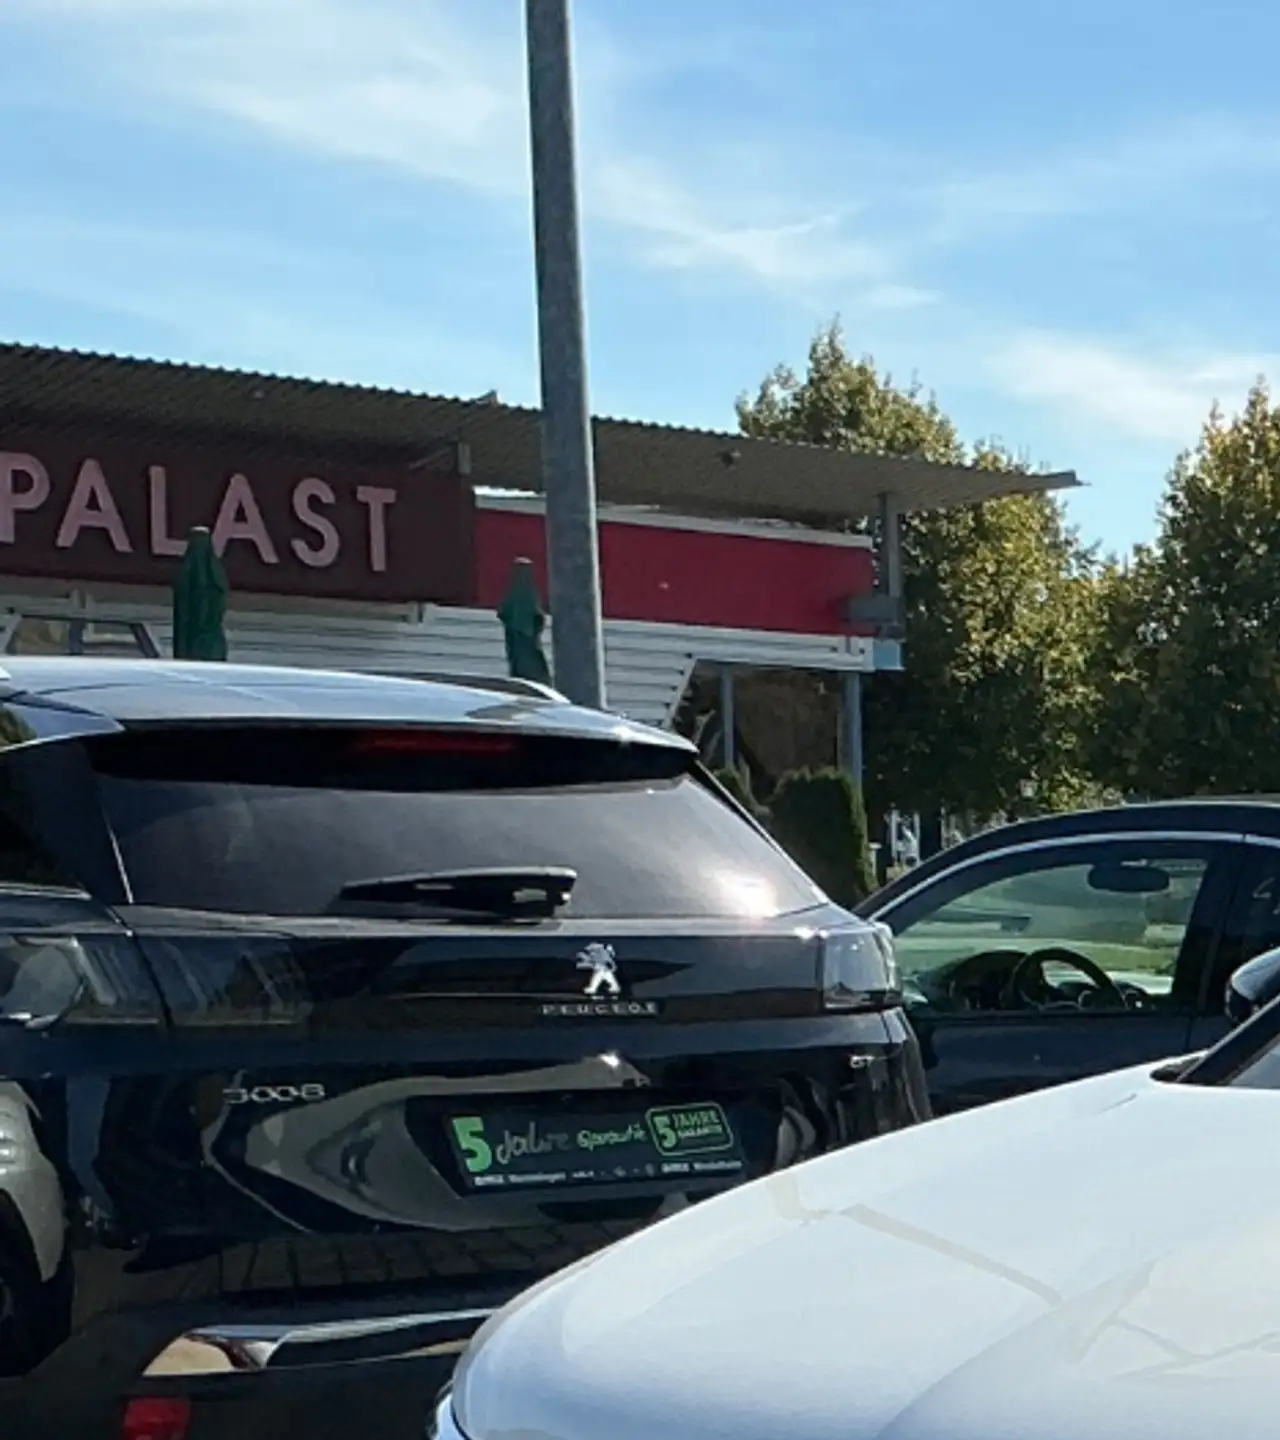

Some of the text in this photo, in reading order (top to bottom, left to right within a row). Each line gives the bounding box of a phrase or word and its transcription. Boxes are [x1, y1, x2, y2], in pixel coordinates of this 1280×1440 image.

[0, 450, 398, 574] PALAST
[222, 1083, 326, 1105] 3008
[452, 1116, 492, 1173] 5
[495, 1121, 570, 1165] Jahre
[653, 1114, 678, 1149] 5
